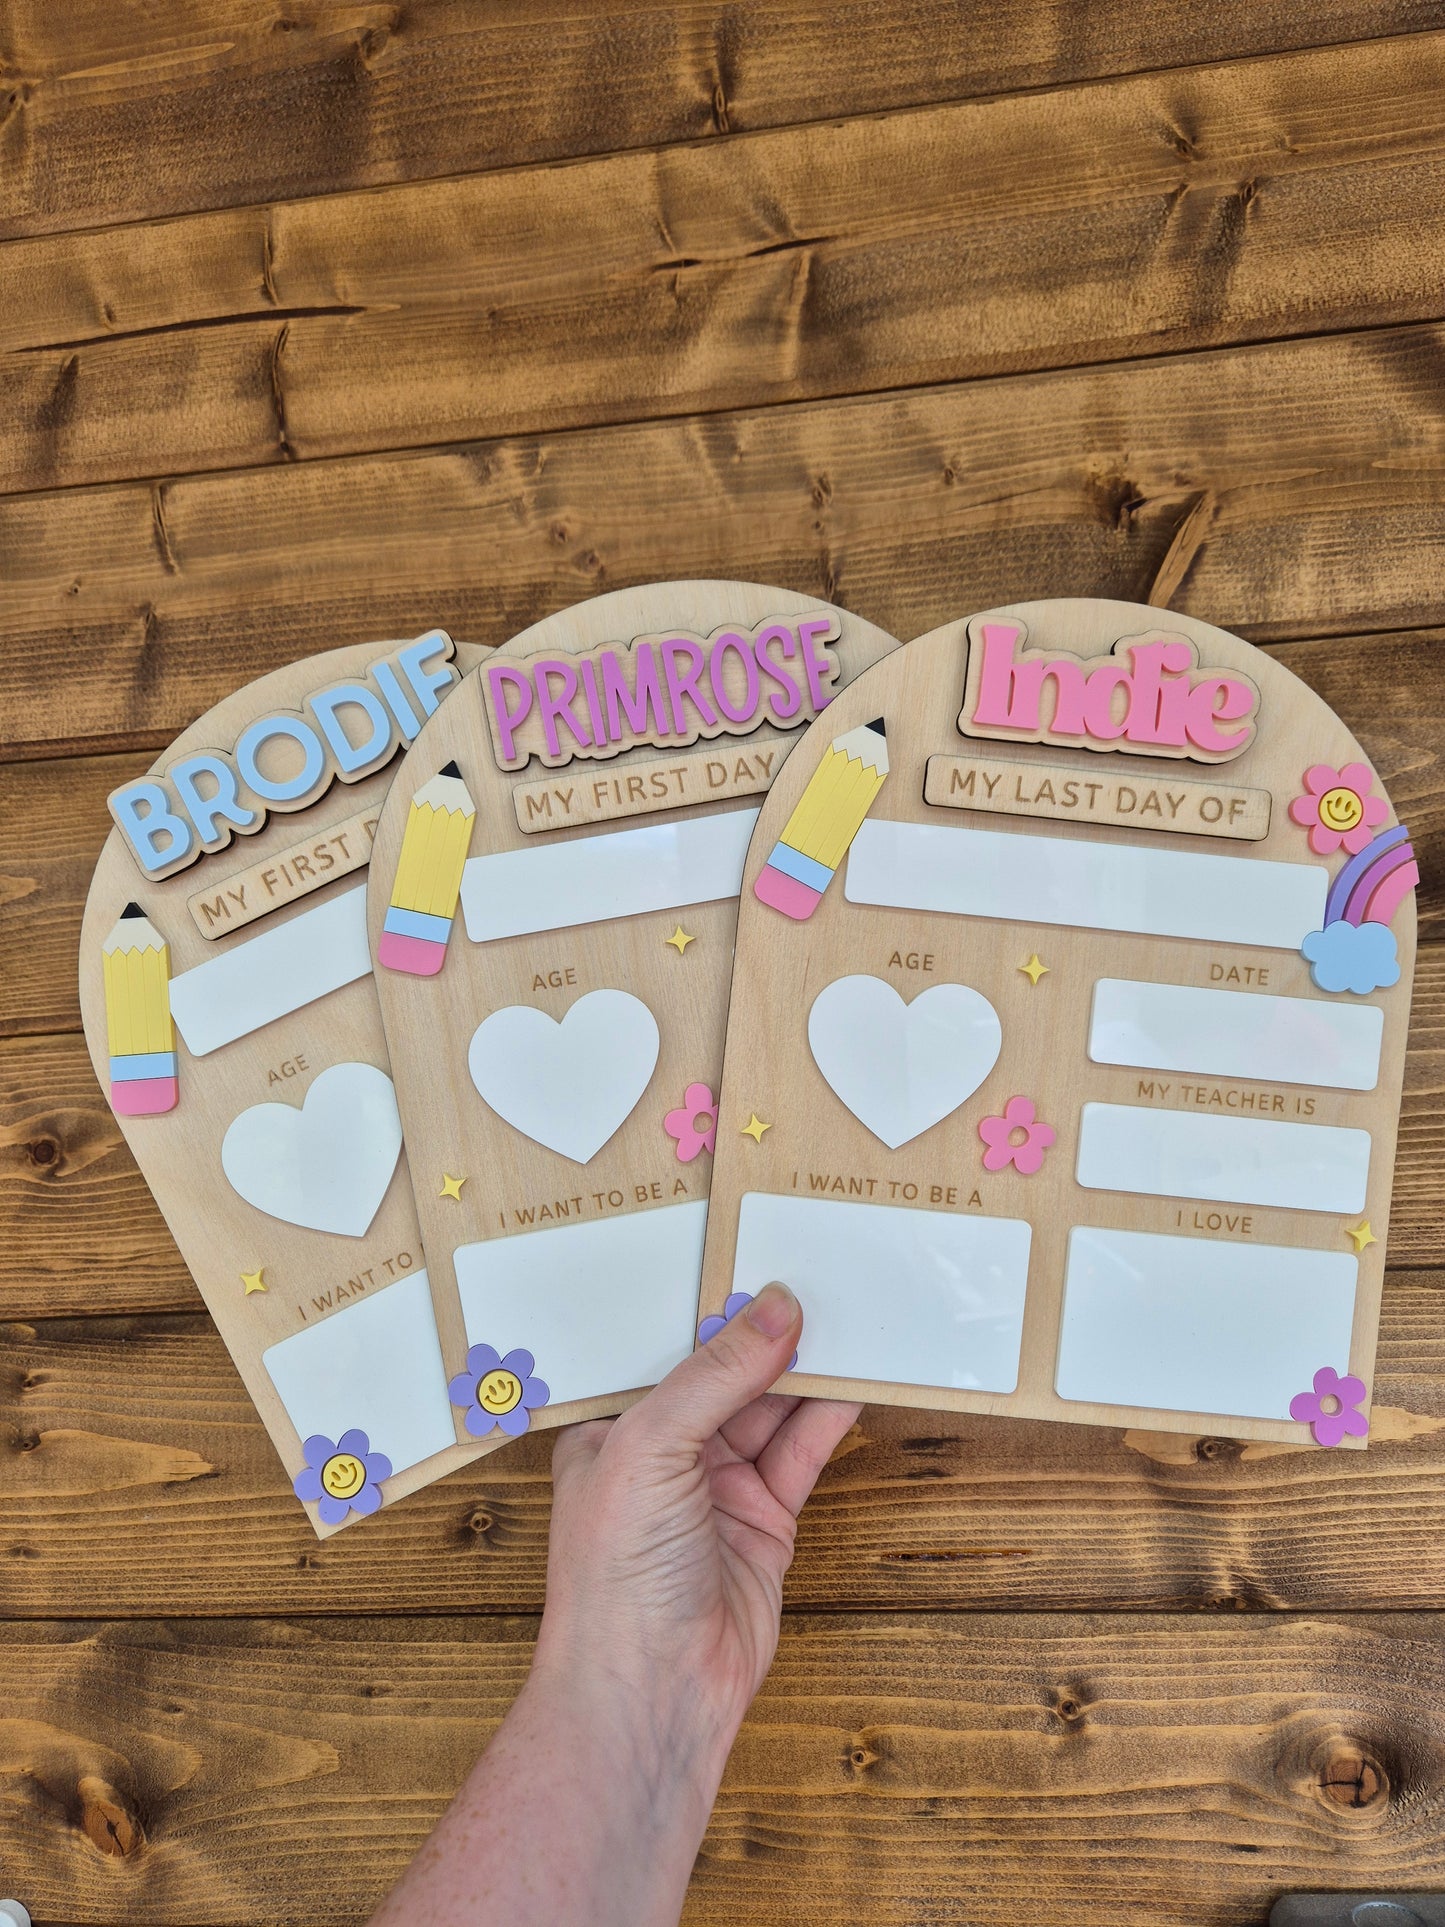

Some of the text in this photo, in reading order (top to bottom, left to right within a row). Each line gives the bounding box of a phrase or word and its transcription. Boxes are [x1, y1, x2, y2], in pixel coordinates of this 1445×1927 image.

[488, 619, 835, 761] PRIMROSE
[972, 624, 1254, 752] Indie
[525, 752, 774, 820] MY FIRST DAY
[950, 768, 1247, 825] MY LAST DAY OF
[200, 833, 350, 927] MY FIRST
[532, 968, 577, 991] AGE
[889, 951, 935, 971] AGE
[1210, 963, 1270, 986] DATE
[267, 1054, 310, 1087] AGE
[1137, 1080, 1316, 1116] MY TEACHER IS
[500, 1178, 688, 1229] I WANT TO BE A
[792, 1171, 983, 1207] I WANT TO BE A
[1176, 1210, 1253, 1234] I LOVE
[298, 1252, 413, 1321] I WANT TO
